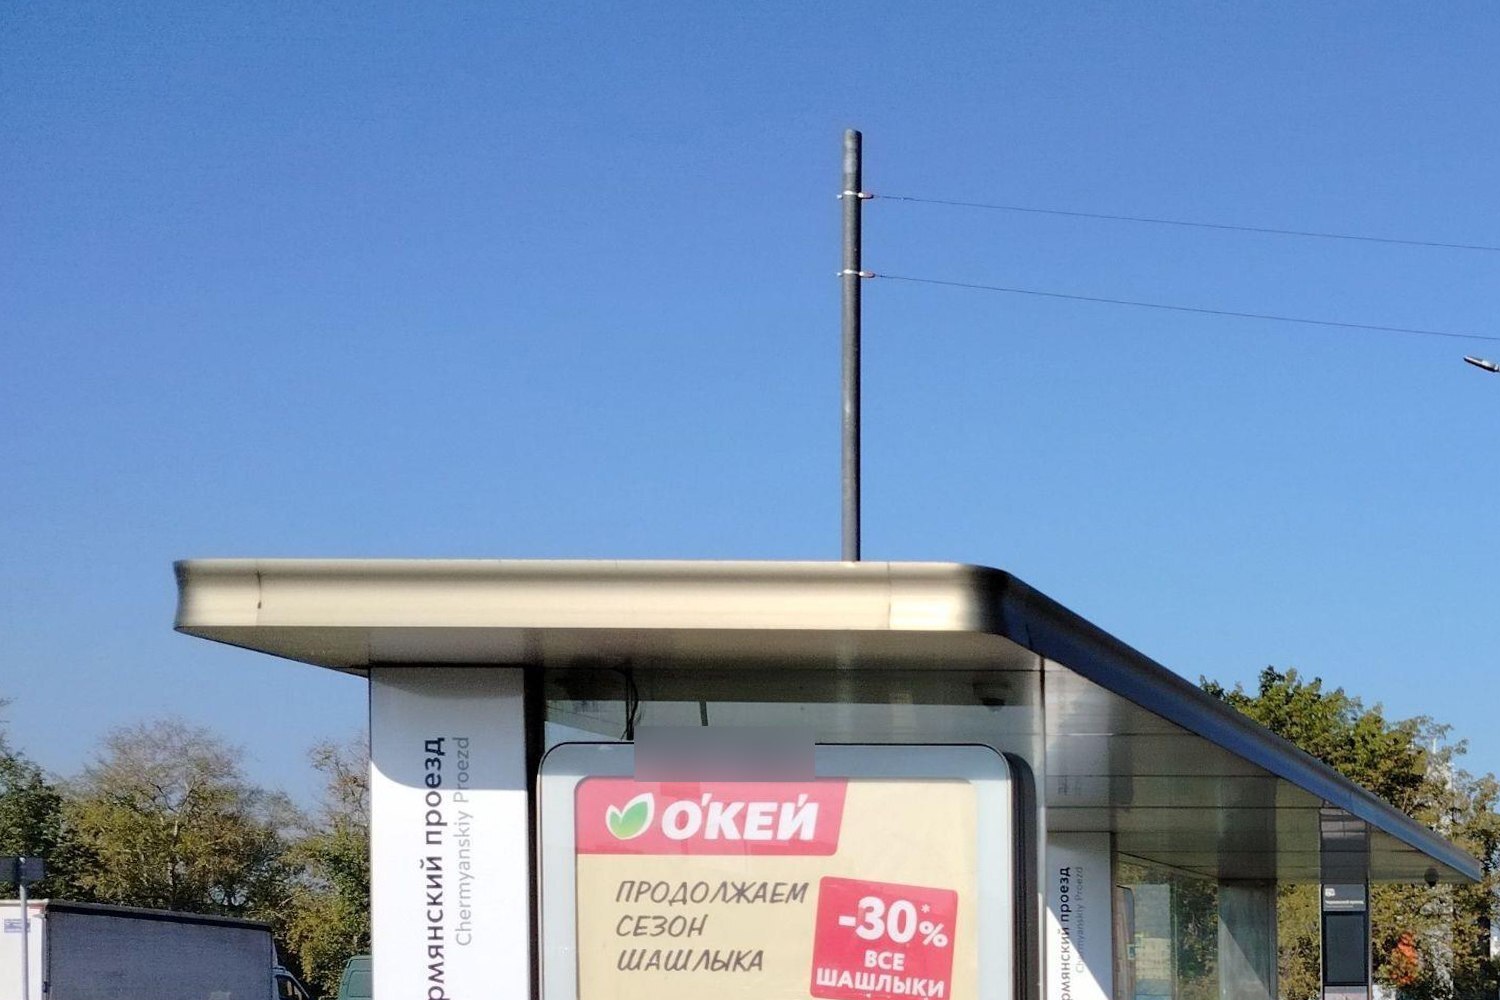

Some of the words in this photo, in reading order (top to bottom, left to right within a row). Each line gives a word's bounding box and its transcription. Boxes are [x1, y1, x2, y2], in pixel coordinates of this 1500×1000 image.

[452, 736, 470, 803] Proezd
[424, 737, 448, 845] проезд
[453, 809, 474, 946] Chermyanskiy
[615, 879, 811, 907] ПРОДОЛЖАЕМ
[1059, 866, 1072, 922] проезд
[616, 913, 709, 938] СЕЗОН
[617, 948, 765, 973] ШАШЛЫКА
[864, 949, 906, 971] ВСЕ
[815, 967, 946, 999] ШАШЛЫКИ
